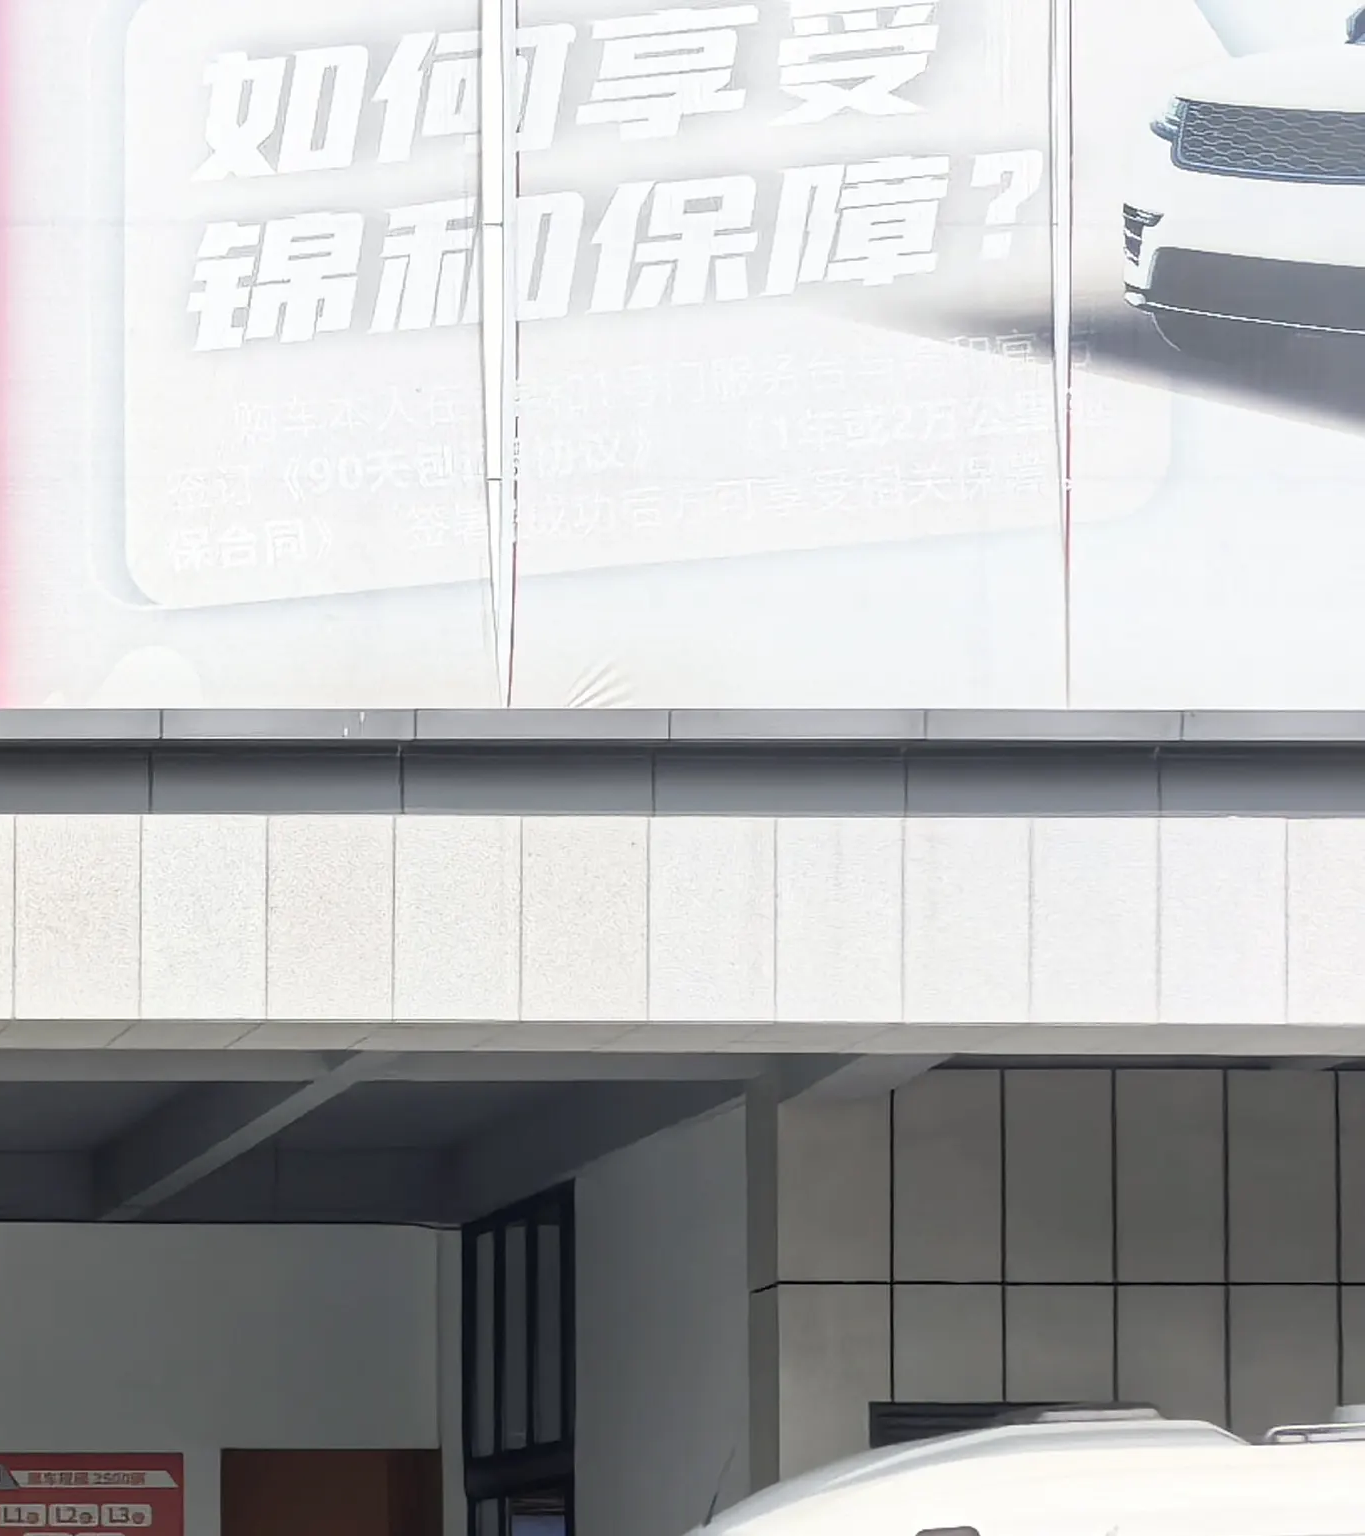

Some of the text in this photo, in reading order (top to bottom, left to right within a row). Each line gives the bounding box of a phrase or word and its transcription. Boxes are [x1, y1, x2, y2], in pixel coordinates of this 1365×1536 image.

[191, 0, 941, 182] 如何享受
[3, 1507, 130, 1523] L1 L2 L3
